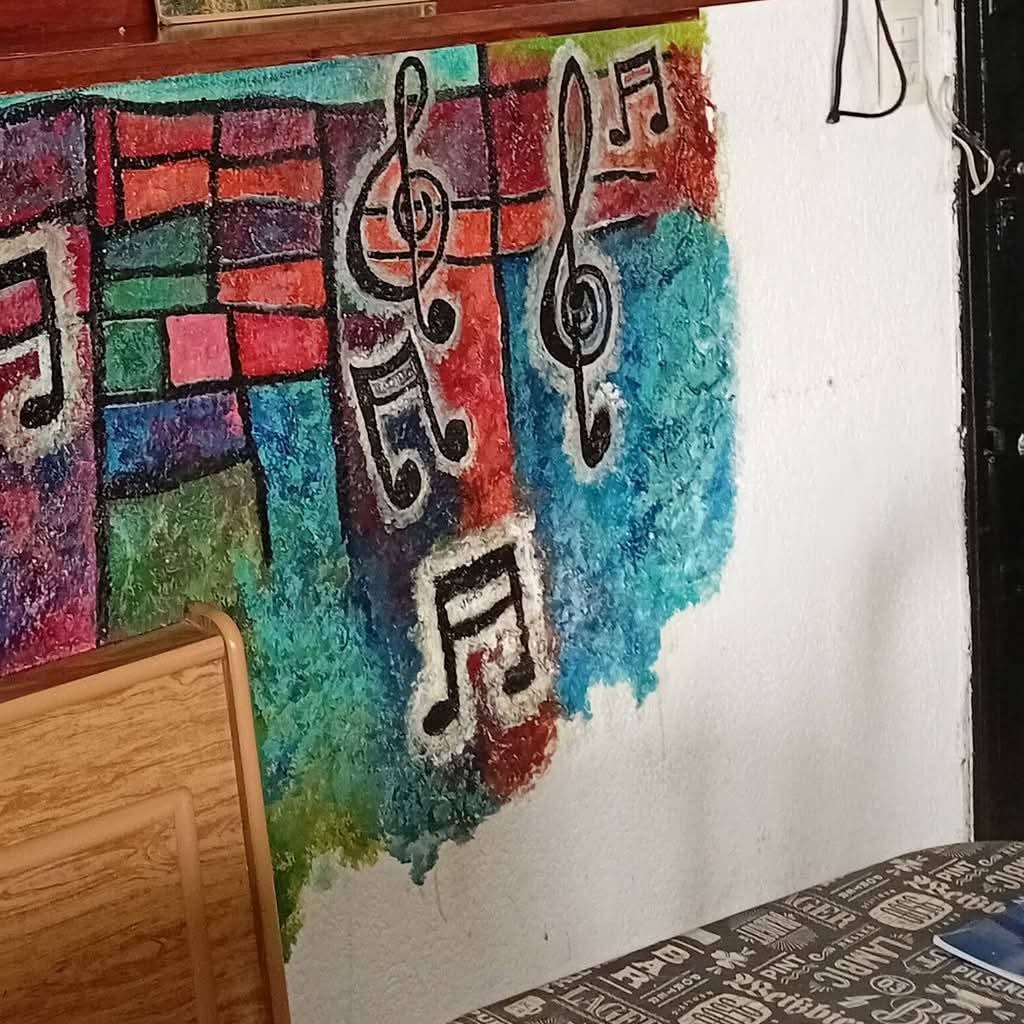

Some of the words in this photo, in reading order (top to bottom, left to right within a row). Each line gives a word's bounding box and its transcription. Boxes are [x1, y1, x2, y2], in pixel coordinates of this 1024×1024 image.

[935, 859, 977, 882] PINT
[759, 953, 806, 981] PINT
[814, 935, 913, 989] LAMBIC
